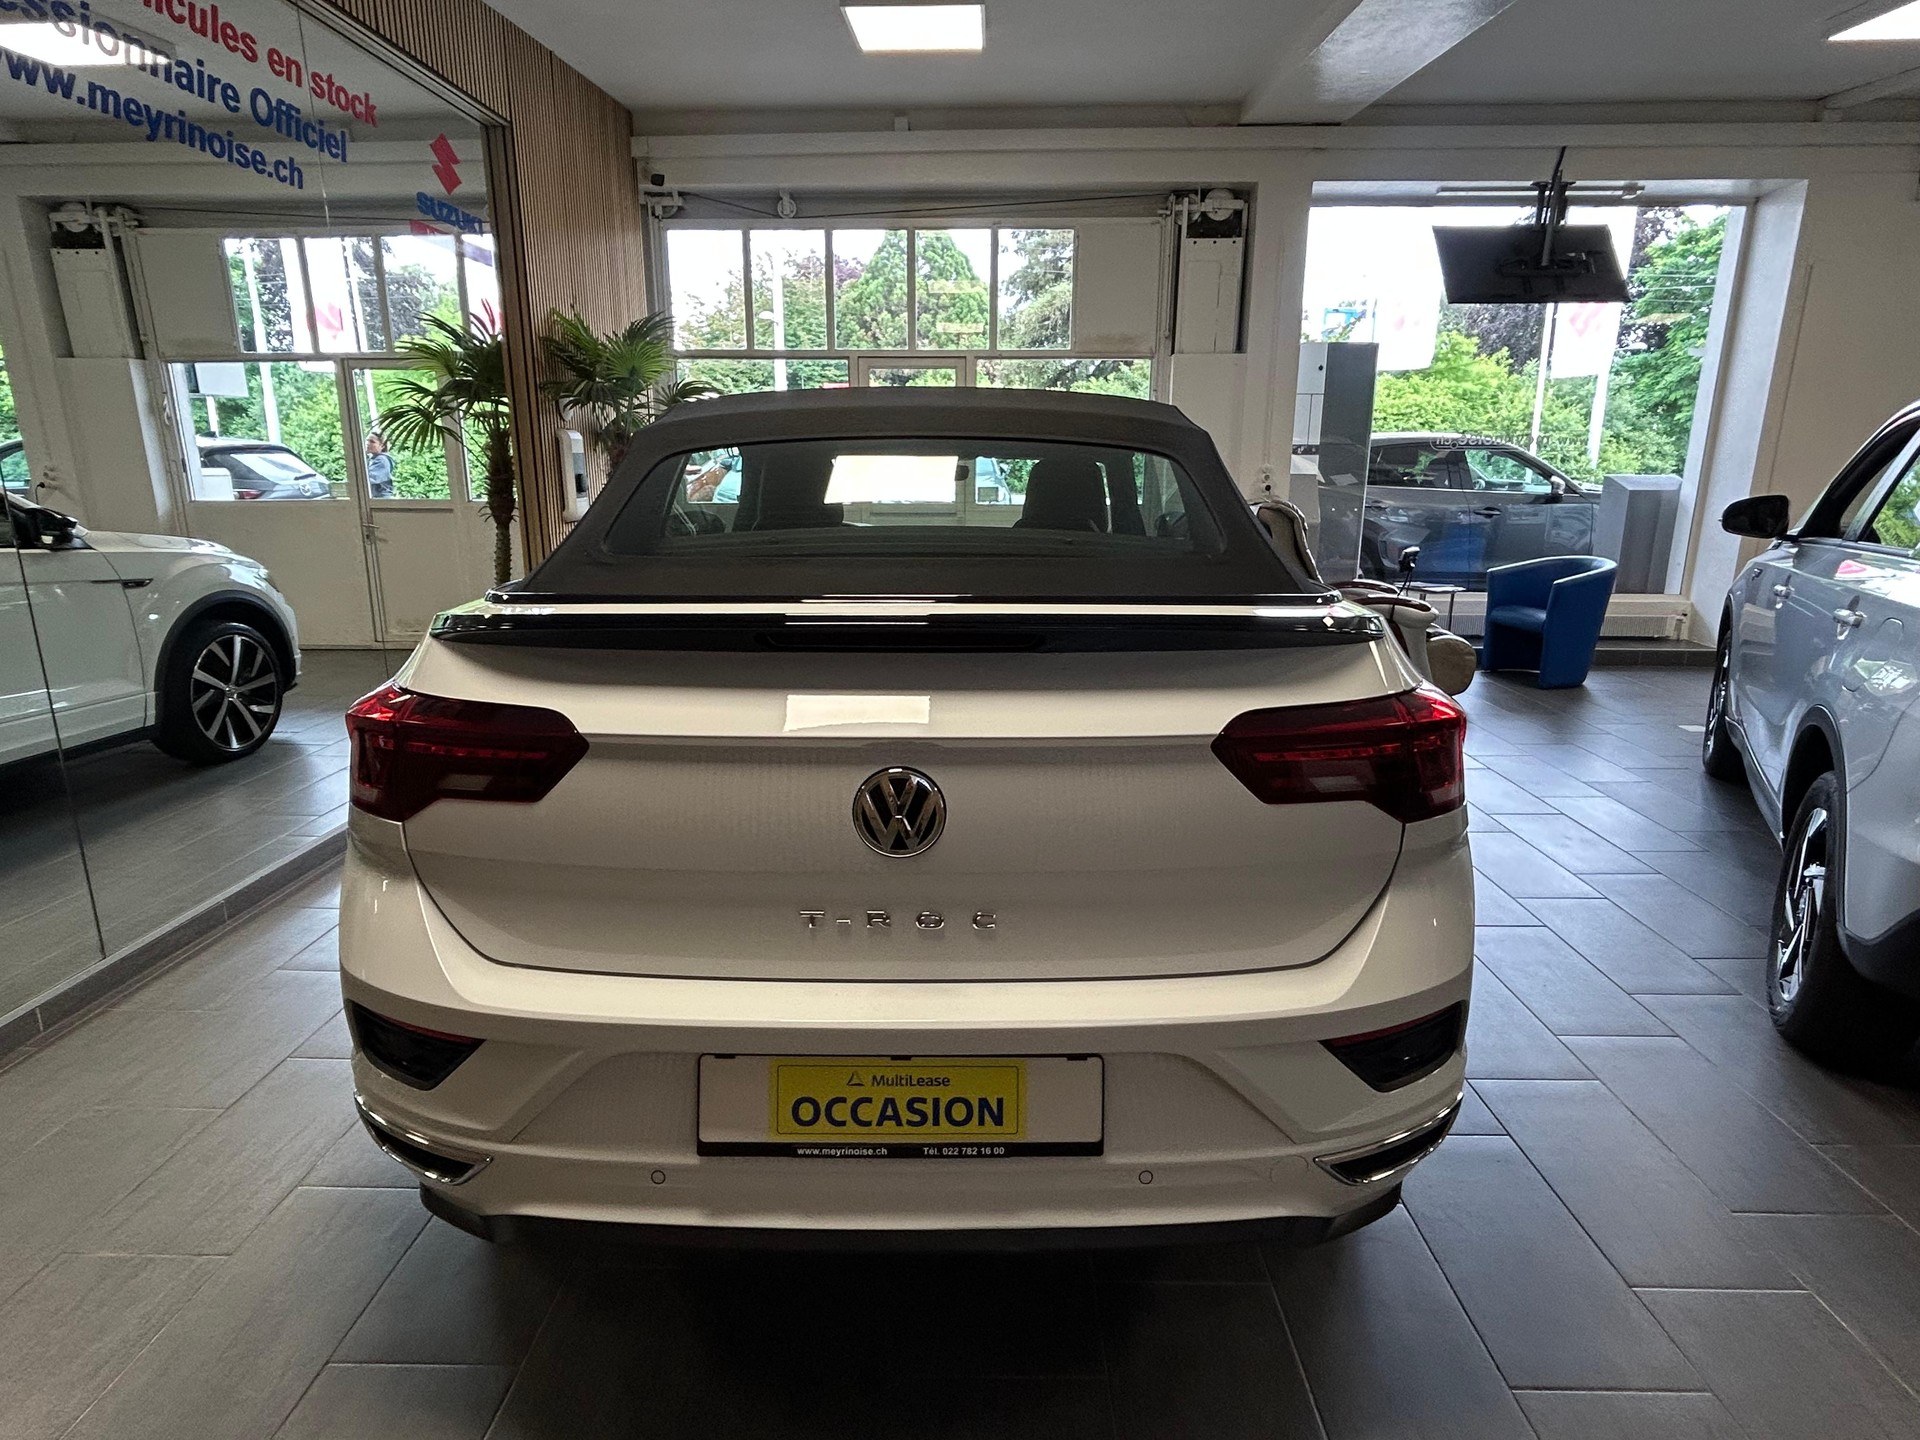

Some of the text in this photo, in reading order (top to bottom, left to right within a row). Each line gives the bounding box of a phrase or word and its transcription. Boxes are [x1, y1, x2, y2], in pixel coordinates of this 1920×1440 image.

[267, 48, 302, 88] en
[310, 71, 378, 128] stock
[0, 47, 304, 189] ww.meyrinoise.ch
[250, 87, 347, 163] Officiel
[416, 191, 483, 237] SUZUKI
[799, 909, 997, 930] T-ROC
[871, 1074, 950, 1087] MultiLease
[791, 1096, 1004, 1128] OCCASION
[796, 1146, 1005, 1157] www.meyrinoise.ch Tél. 022 782 16 00
